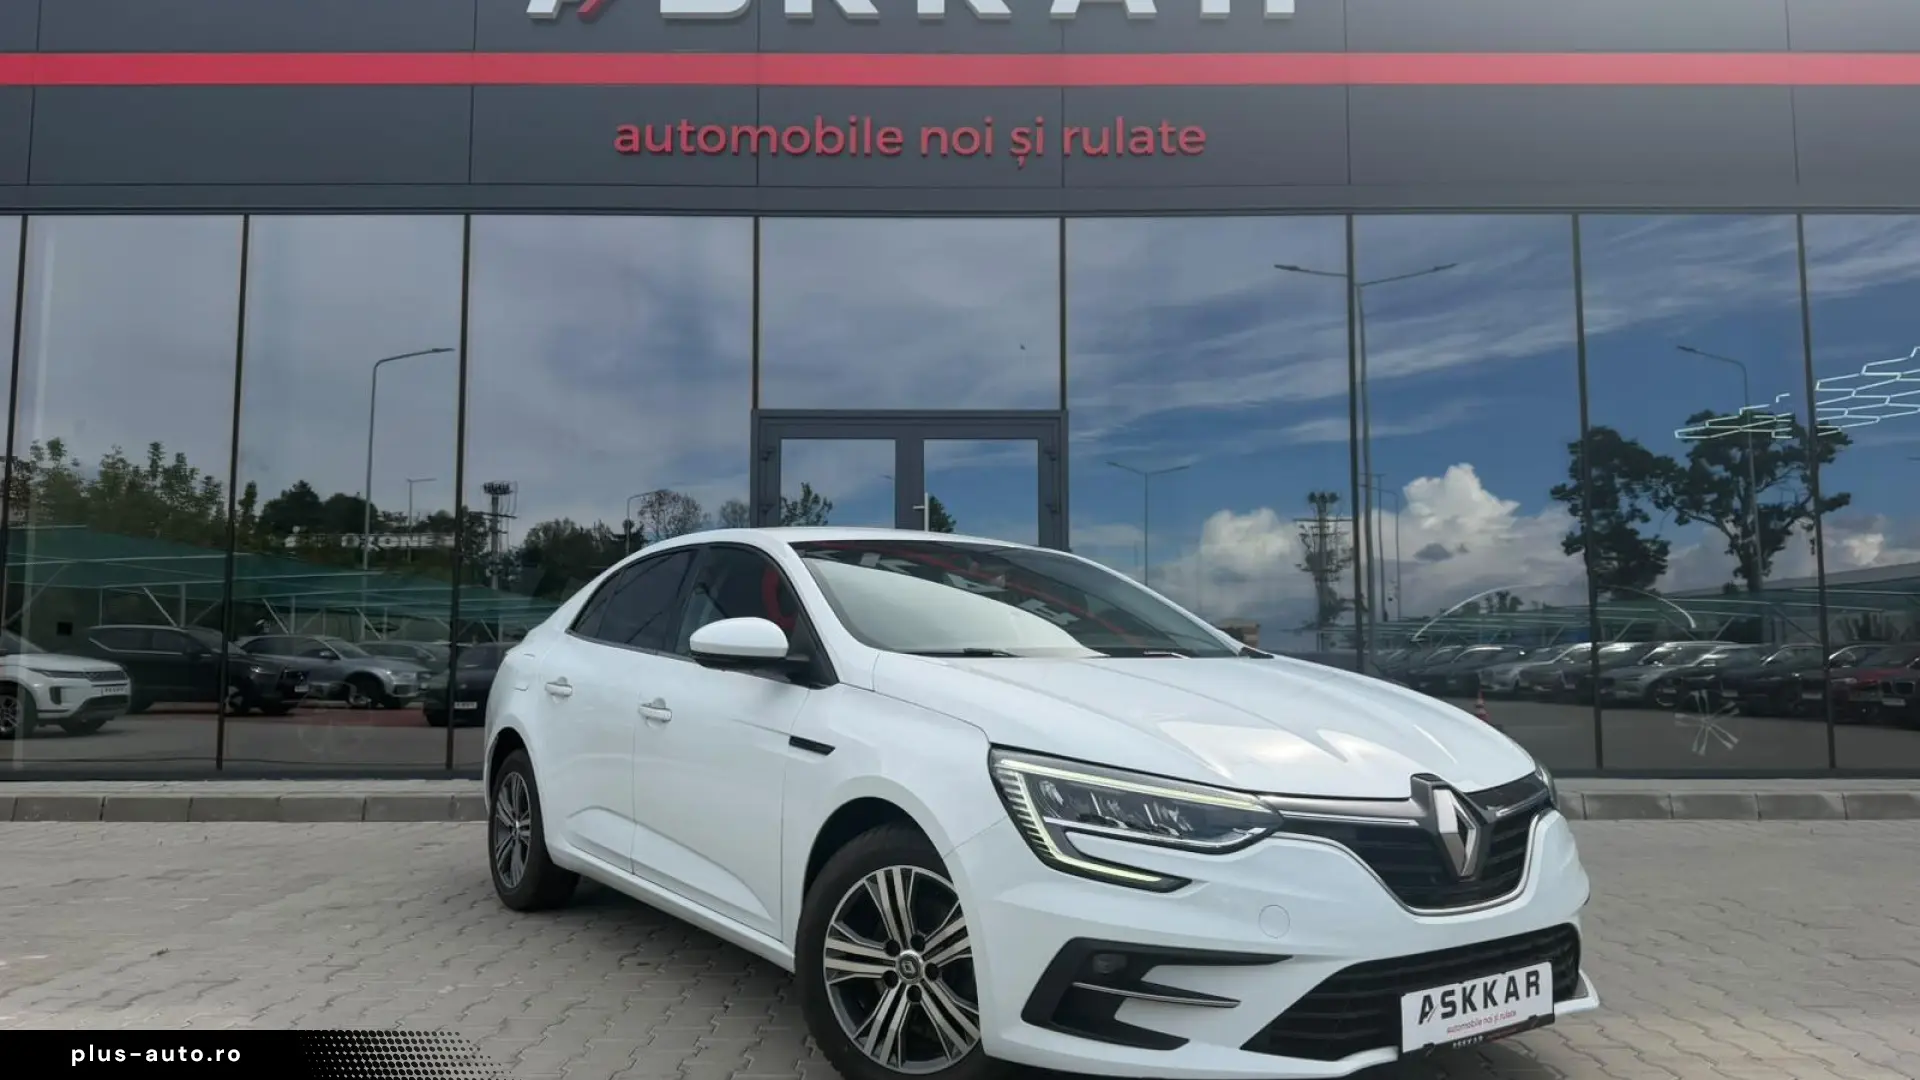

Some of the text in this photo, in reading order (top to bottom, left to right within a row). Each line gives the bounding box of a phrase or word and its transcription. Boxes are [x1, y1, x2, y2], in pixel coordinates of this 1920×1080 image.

[613, 115, 1208, 170] automobile noi și rulate
[1418, 969, 1540, 1026] ASKKAR
